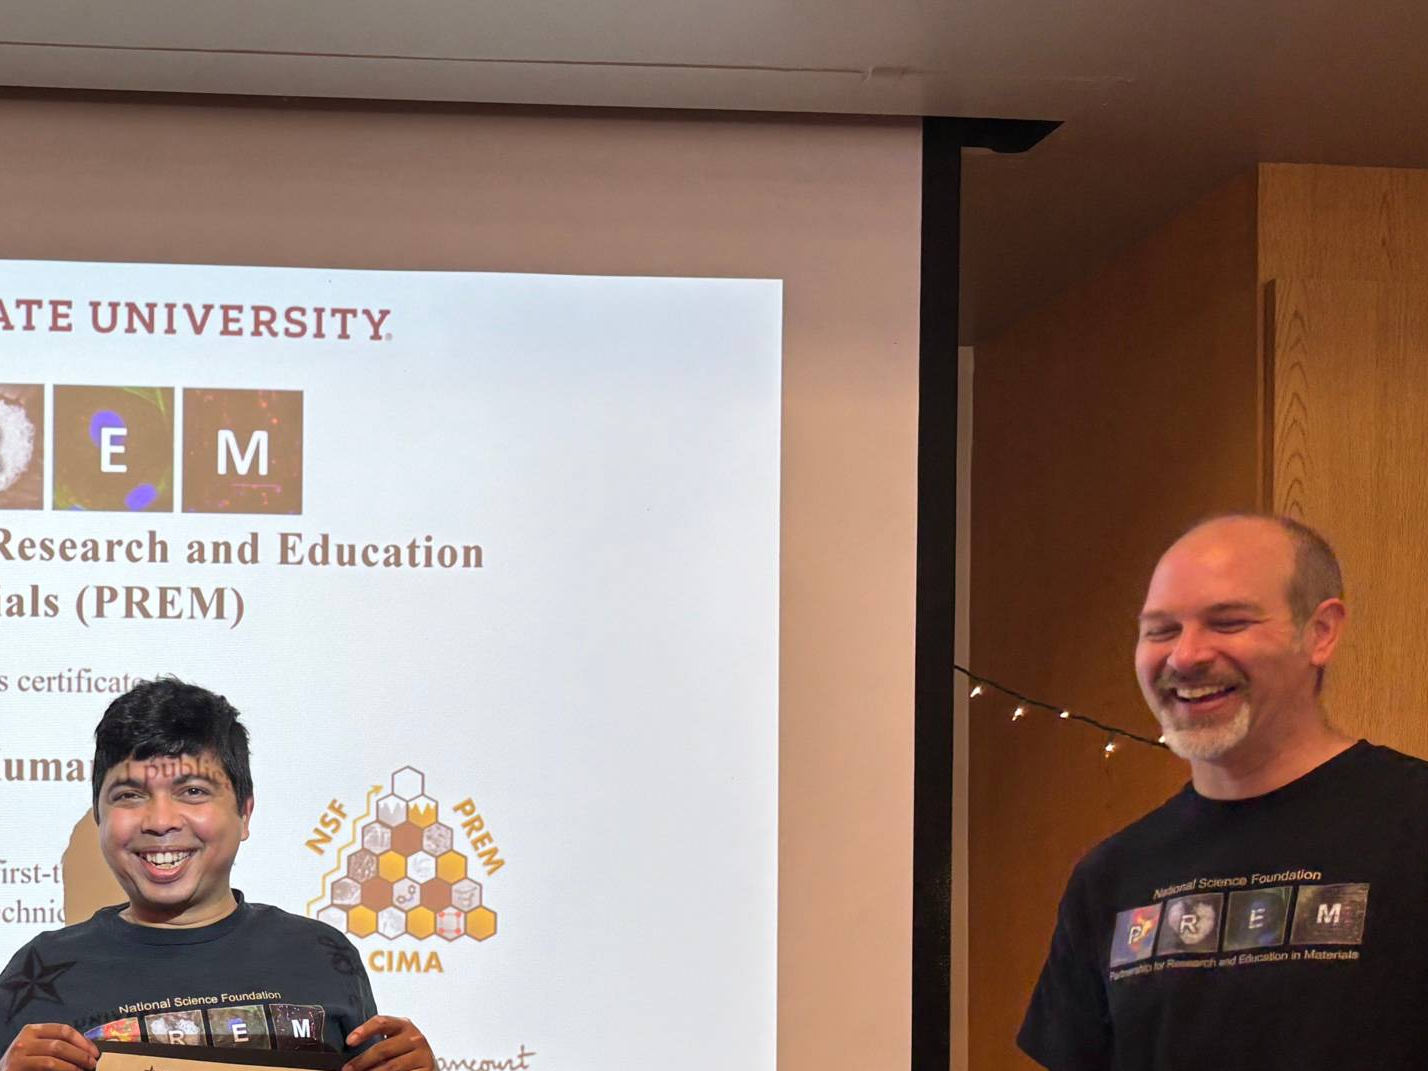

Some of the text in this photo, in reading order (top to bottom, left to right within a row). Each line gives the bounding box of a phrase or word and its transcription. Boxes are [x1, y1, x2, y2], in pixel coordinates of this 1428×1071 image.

[89, 300, 391, 341] UNIVERSITY
[186, 531, 260, 565] and
[277, 532, 484, 569] Education
[75, 585, 245, 629] (PREM)
[304, 798, 349, 855] NSF
[452, 797, 506, 876] PREM
[1153, 869, 1322, 900] National Science Foundation
[368, 950, 444, 973] CIMA
[1238, 951, 1288, 965] Education
[1291, 949, 1301, 961] in
[1304, 948, 1360, 961] Materials
[118, 989, 282, 1015] National Science Foundation
